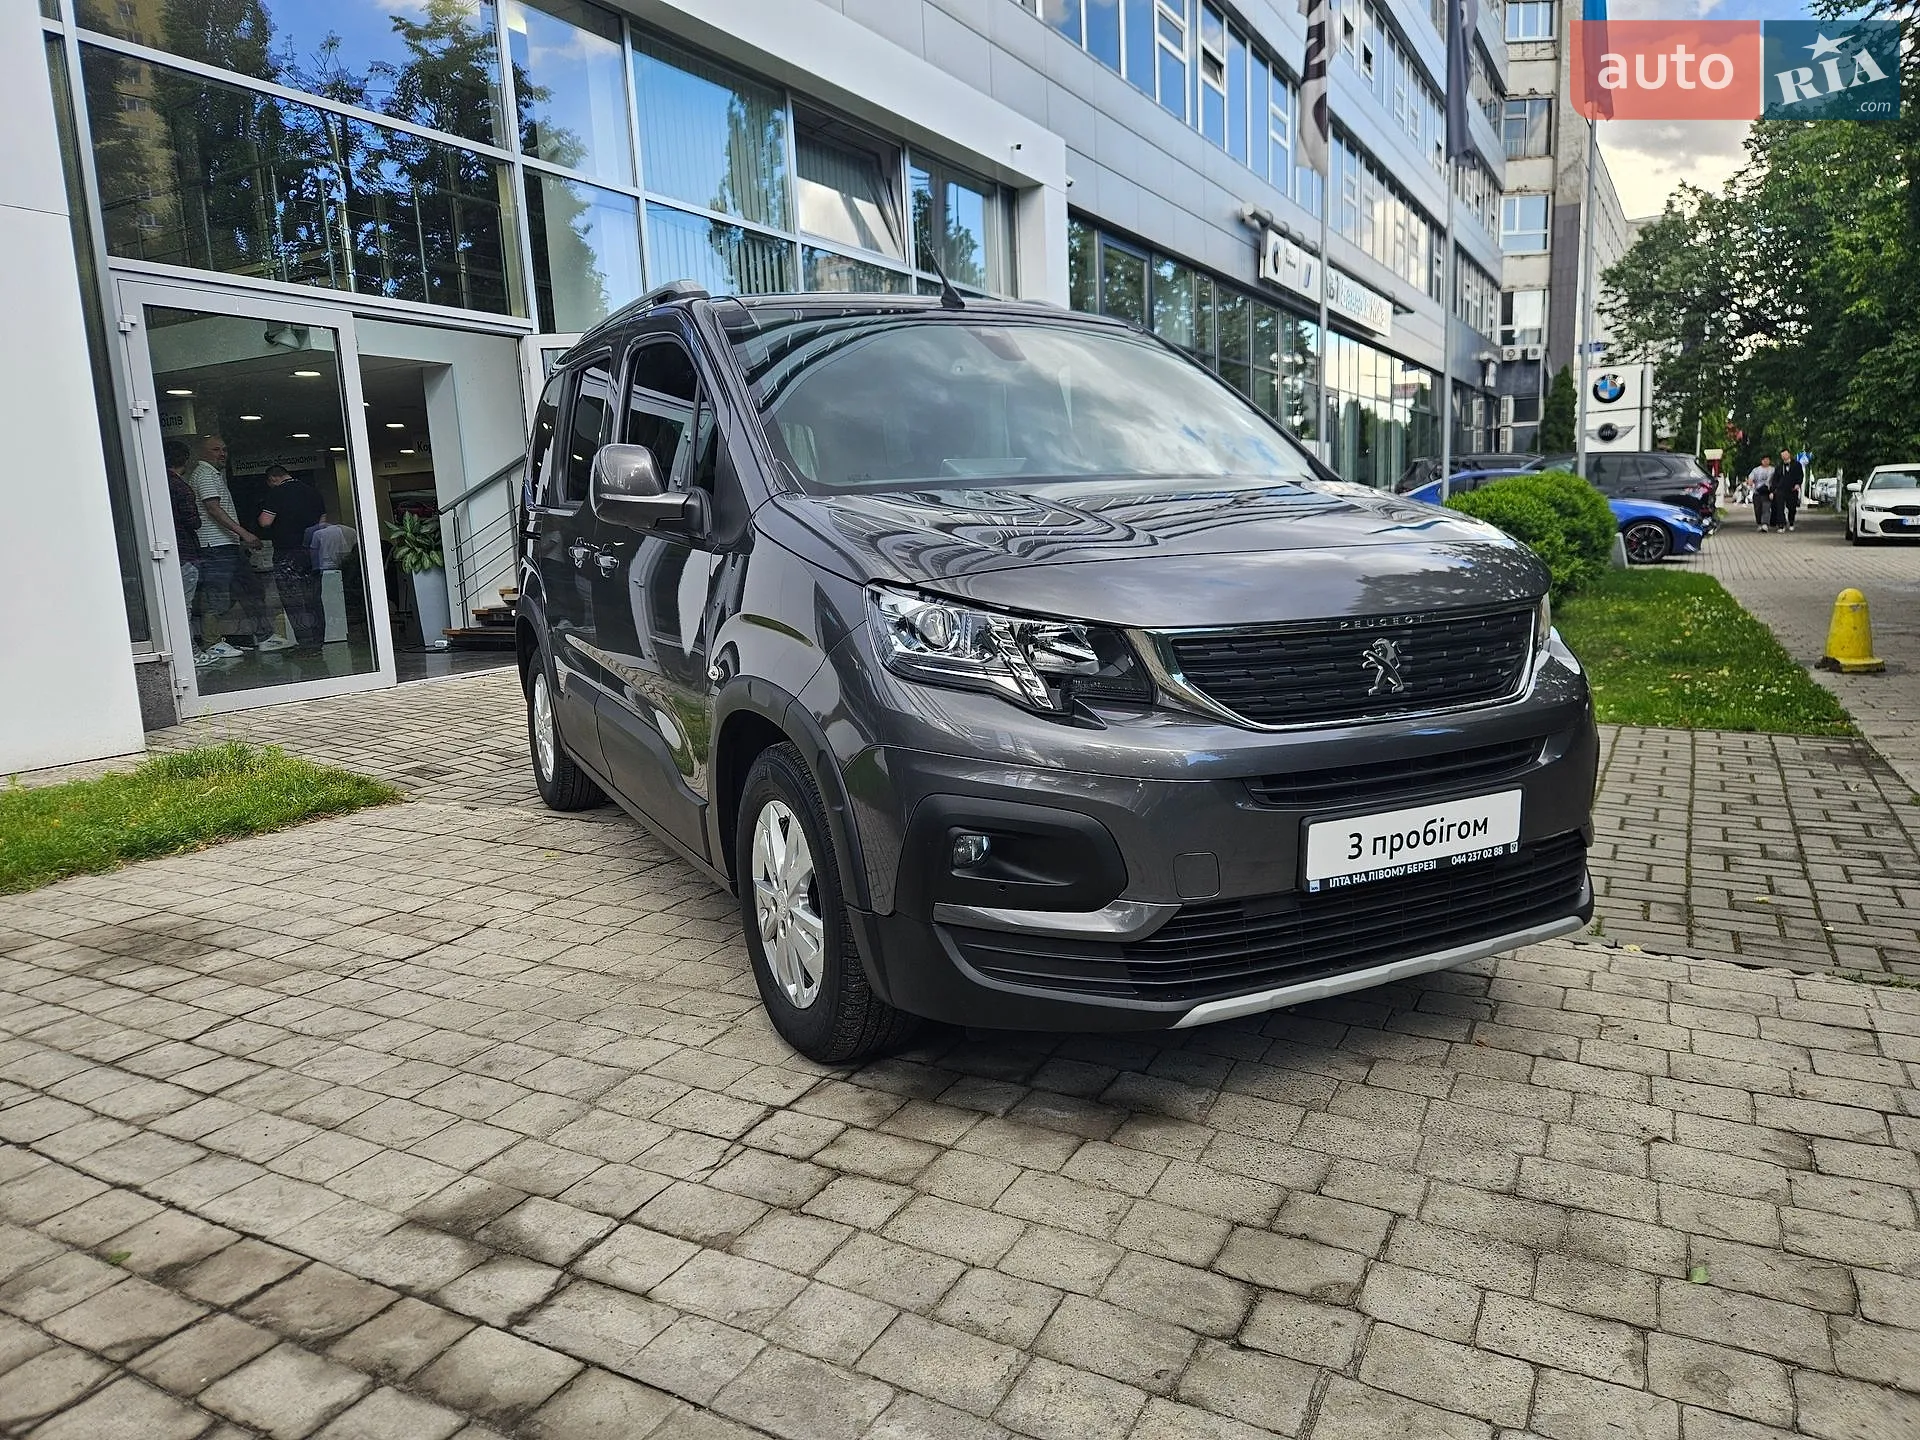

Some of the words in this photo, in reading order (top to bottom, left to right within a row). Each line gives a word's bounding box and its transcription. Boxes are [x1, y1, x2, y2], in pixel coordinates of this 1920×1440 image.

[1340, 614, 1425, 630] PEUGEOT
[1372, 816, 1489, 860] пробігом
[1329, 876, 1351, 888] ІЛТА
[1352, 874, 1367, 884] НА
[1368, 866, 1406, 882] ЛІВОМУ
[1407, 860, 1437, 874] БЕРЕЗІ
[1451, 853, 1467, 865] 044
[1468, 850, 1482, 862] 237
[1482, 848, 1493, 859] 02
[1493, 846, 1504, 856] 88
